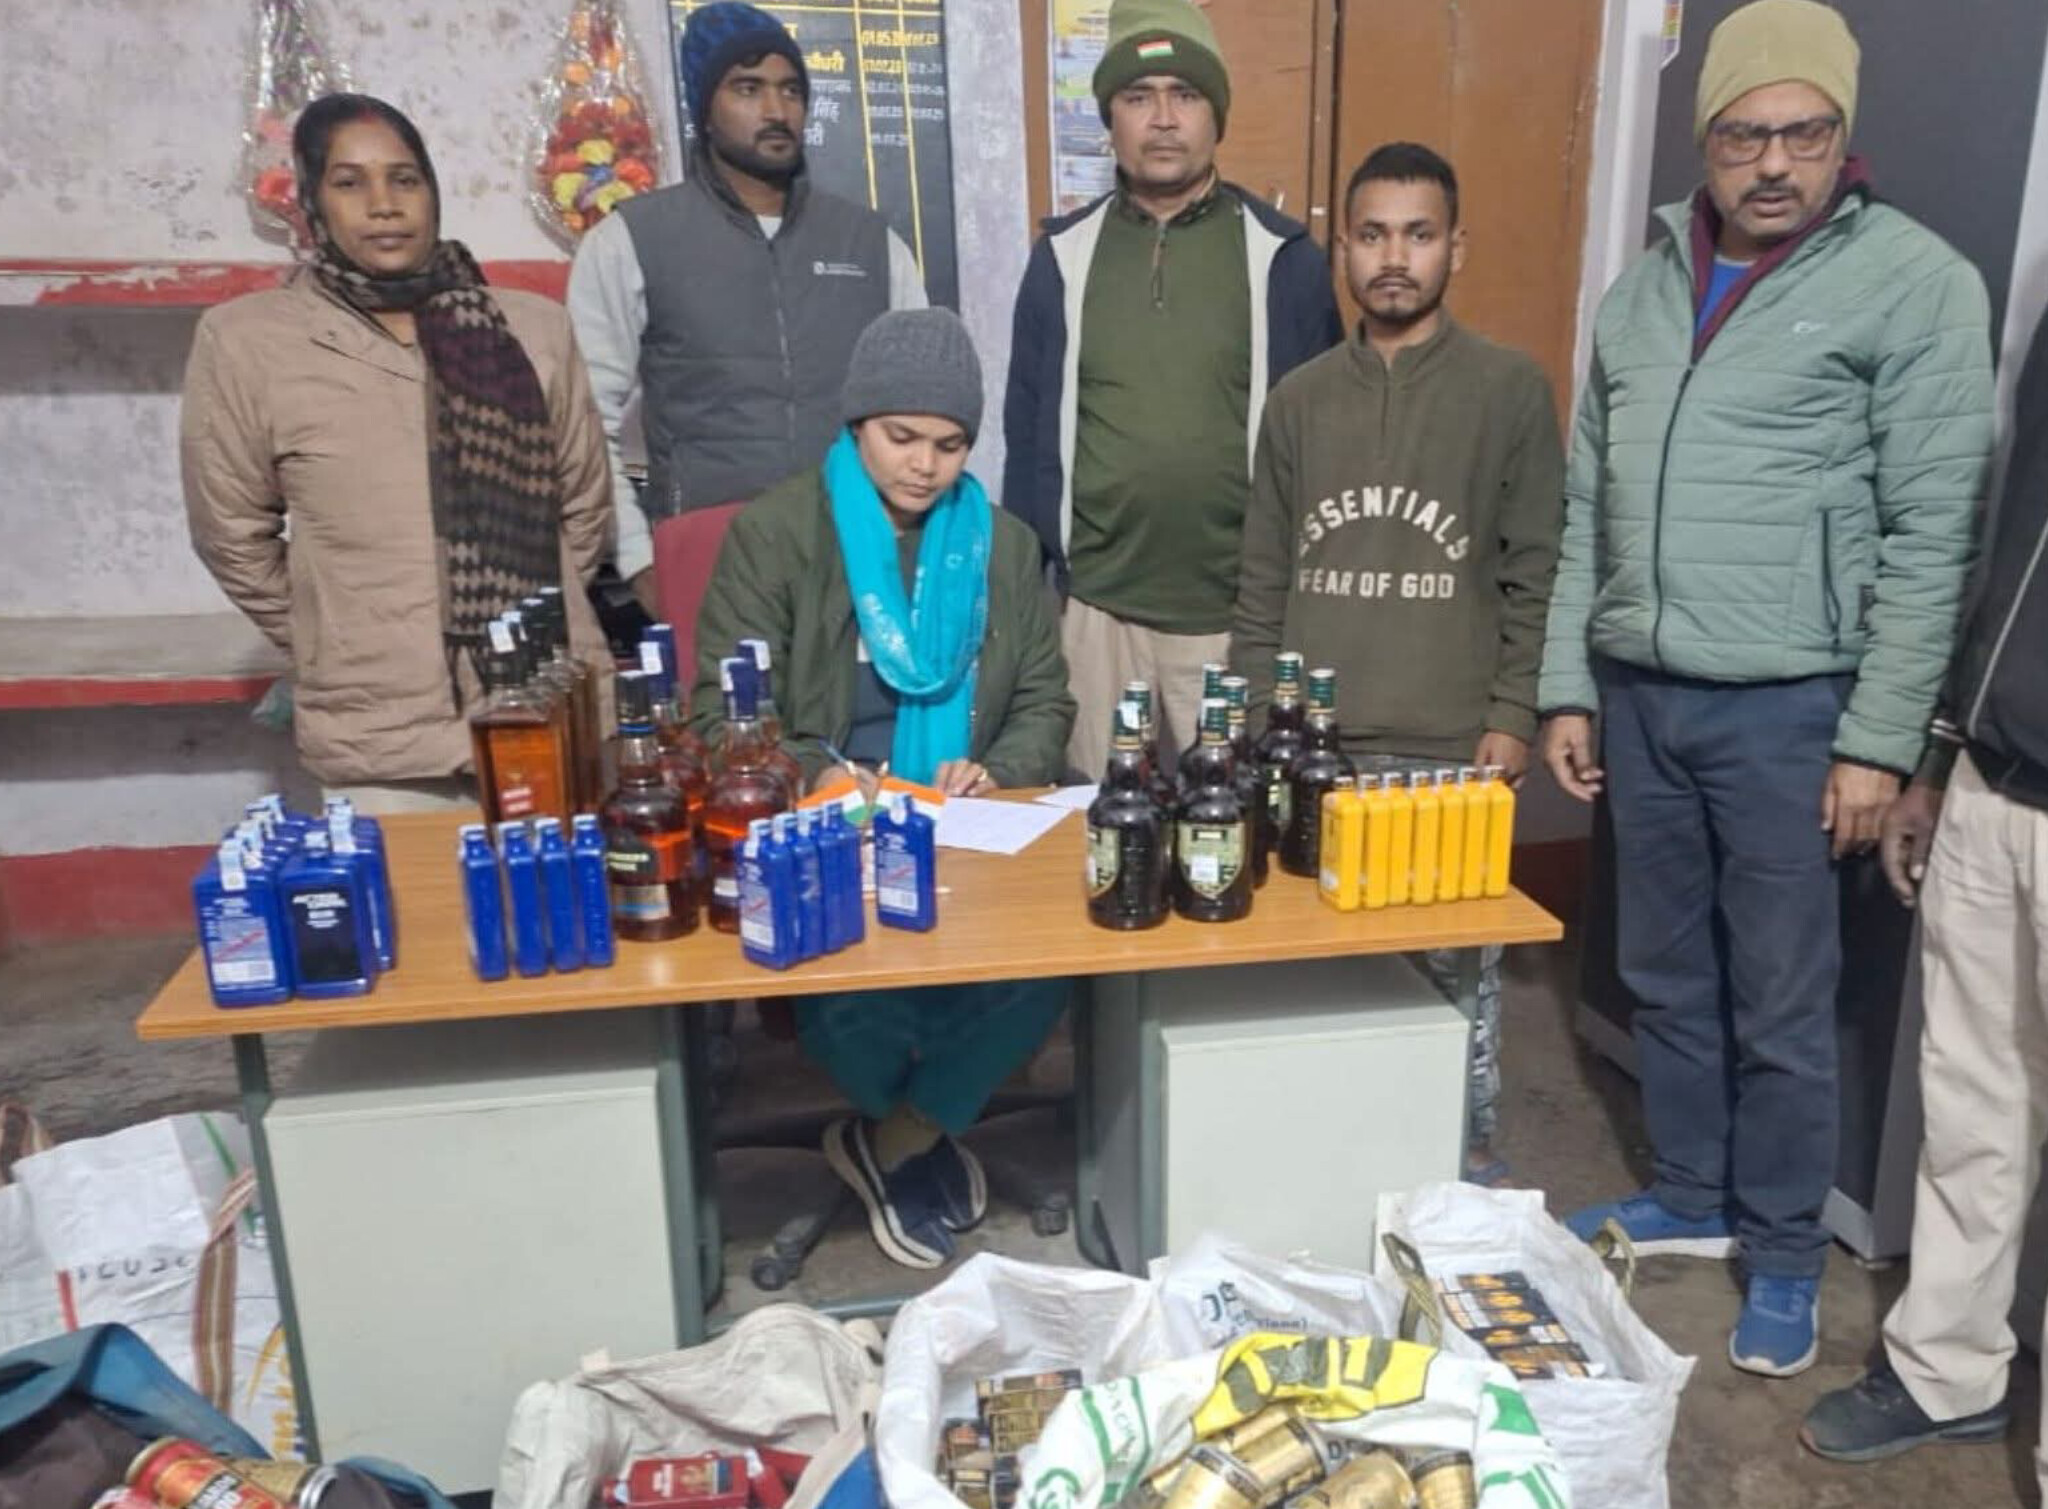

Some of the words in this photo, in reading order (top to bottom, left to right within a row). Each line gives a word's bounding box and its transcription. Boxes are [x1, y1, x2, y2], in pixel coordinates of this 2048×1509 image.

[1298, 568, 1353, 597] FEAR
[1359, 571, 1392, 598] OF
[1401, 572, 1455, 599] GOD
